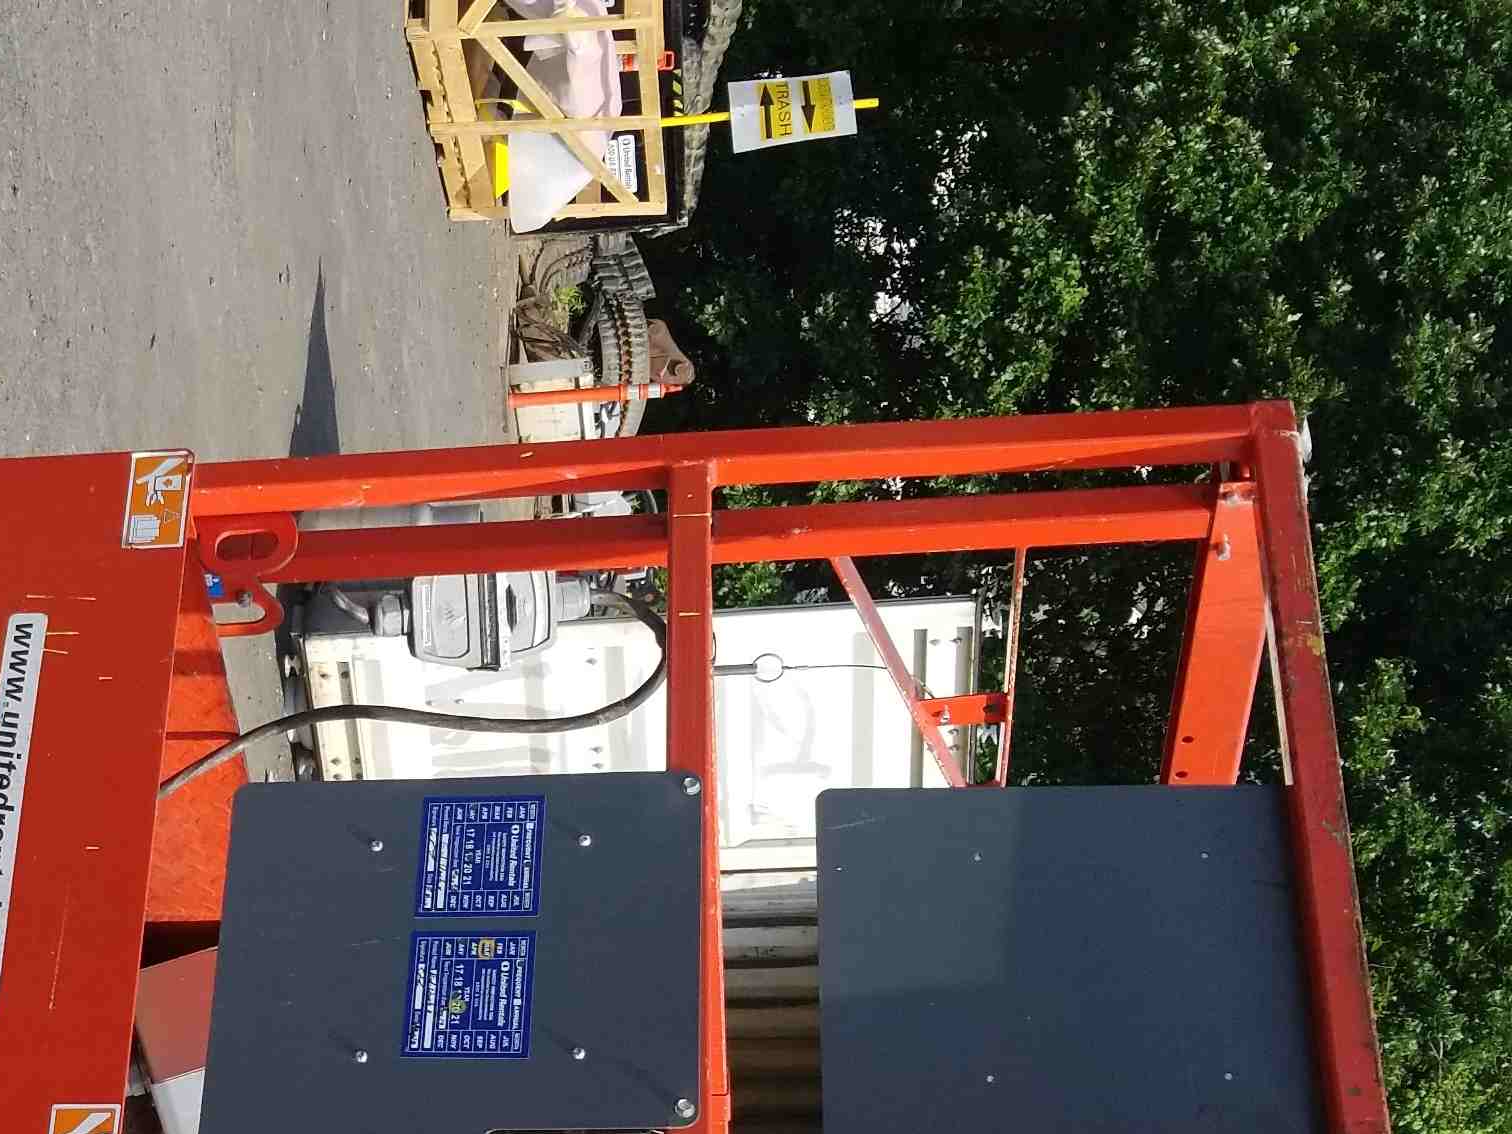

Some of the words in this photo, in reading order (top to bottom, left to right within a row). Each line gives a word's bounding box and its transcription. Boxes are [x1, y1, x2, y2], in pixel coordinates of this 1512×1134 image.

[776, 81, 792, 137] TRASH
[466, 829, 474, 837] 17
[465, 840, 474, 849] 18
[463, 864, 472, 874] 20
[463, 876, 471, 885] 21
[455, 964, 464, 974] 17
[454, 977, 463, 987] 18
[451, 1014, 459, 1025] 21
